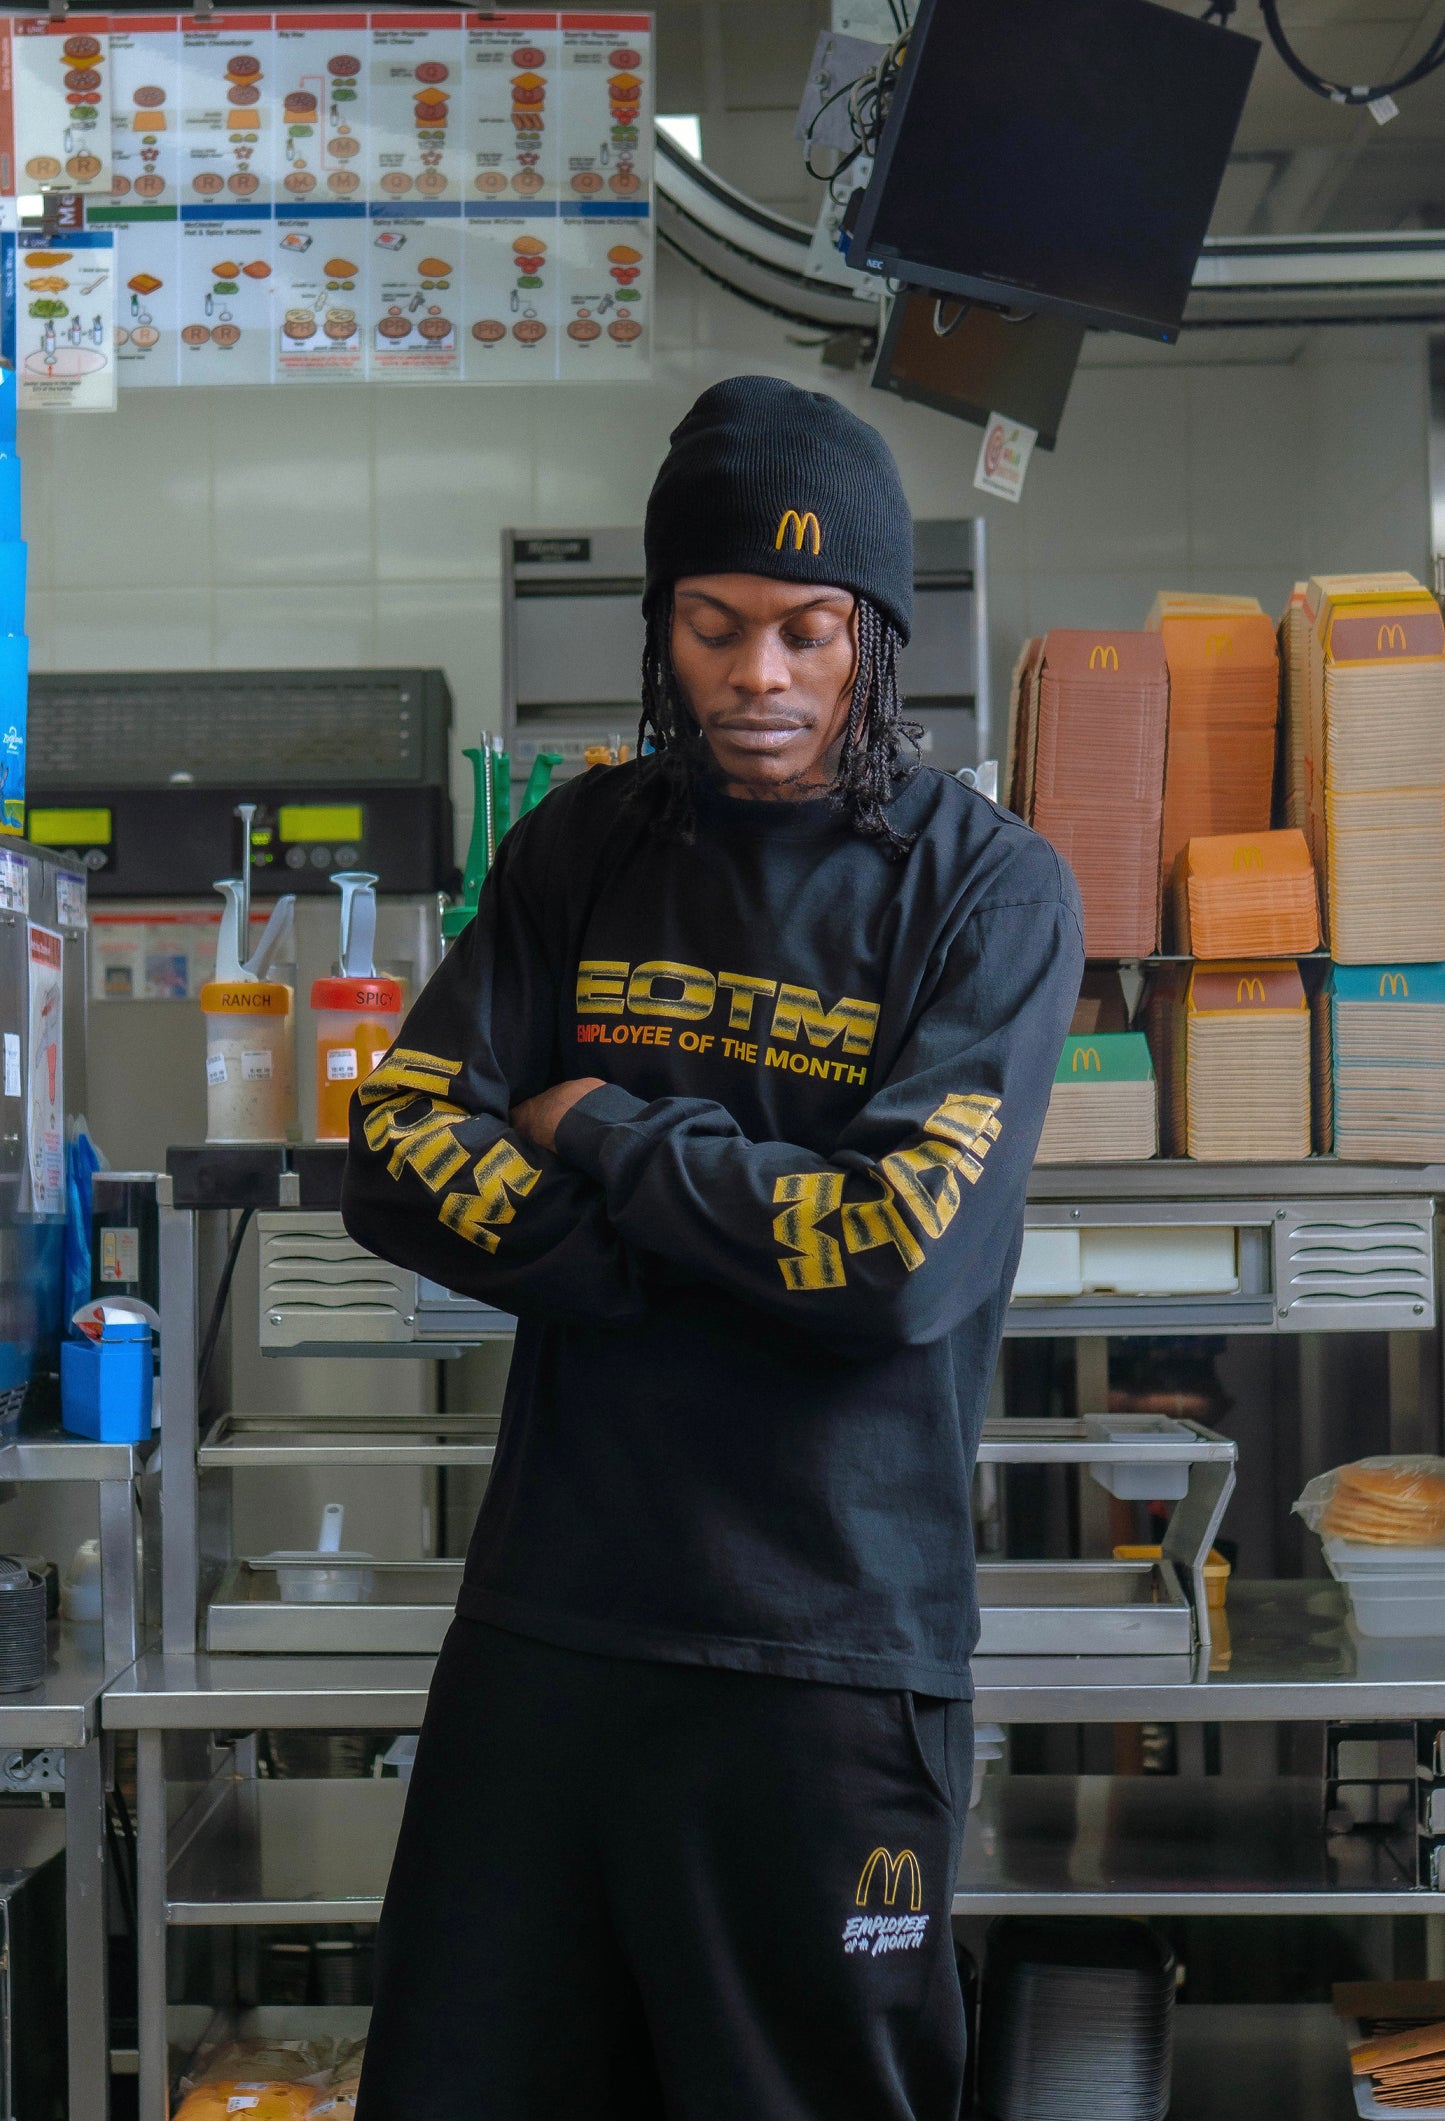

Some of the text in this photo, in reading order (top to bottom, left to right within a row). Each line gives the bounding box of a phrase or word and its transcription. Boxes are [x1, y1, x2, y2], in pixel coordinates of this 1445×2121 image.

[866, 259, 884, 270] NEC
[221, 993, 272, 1008] RANCH
[355, 991, 394, 1006] SPICY
[575, 959, 881, 1056] EOTM
[576, 1023, 868, 1086] EMPLOYEE OF THE MONTH
[841, 1914, 930, 1941] EMPLOYEE
[871, 1931, 924, 1958] MONTH
